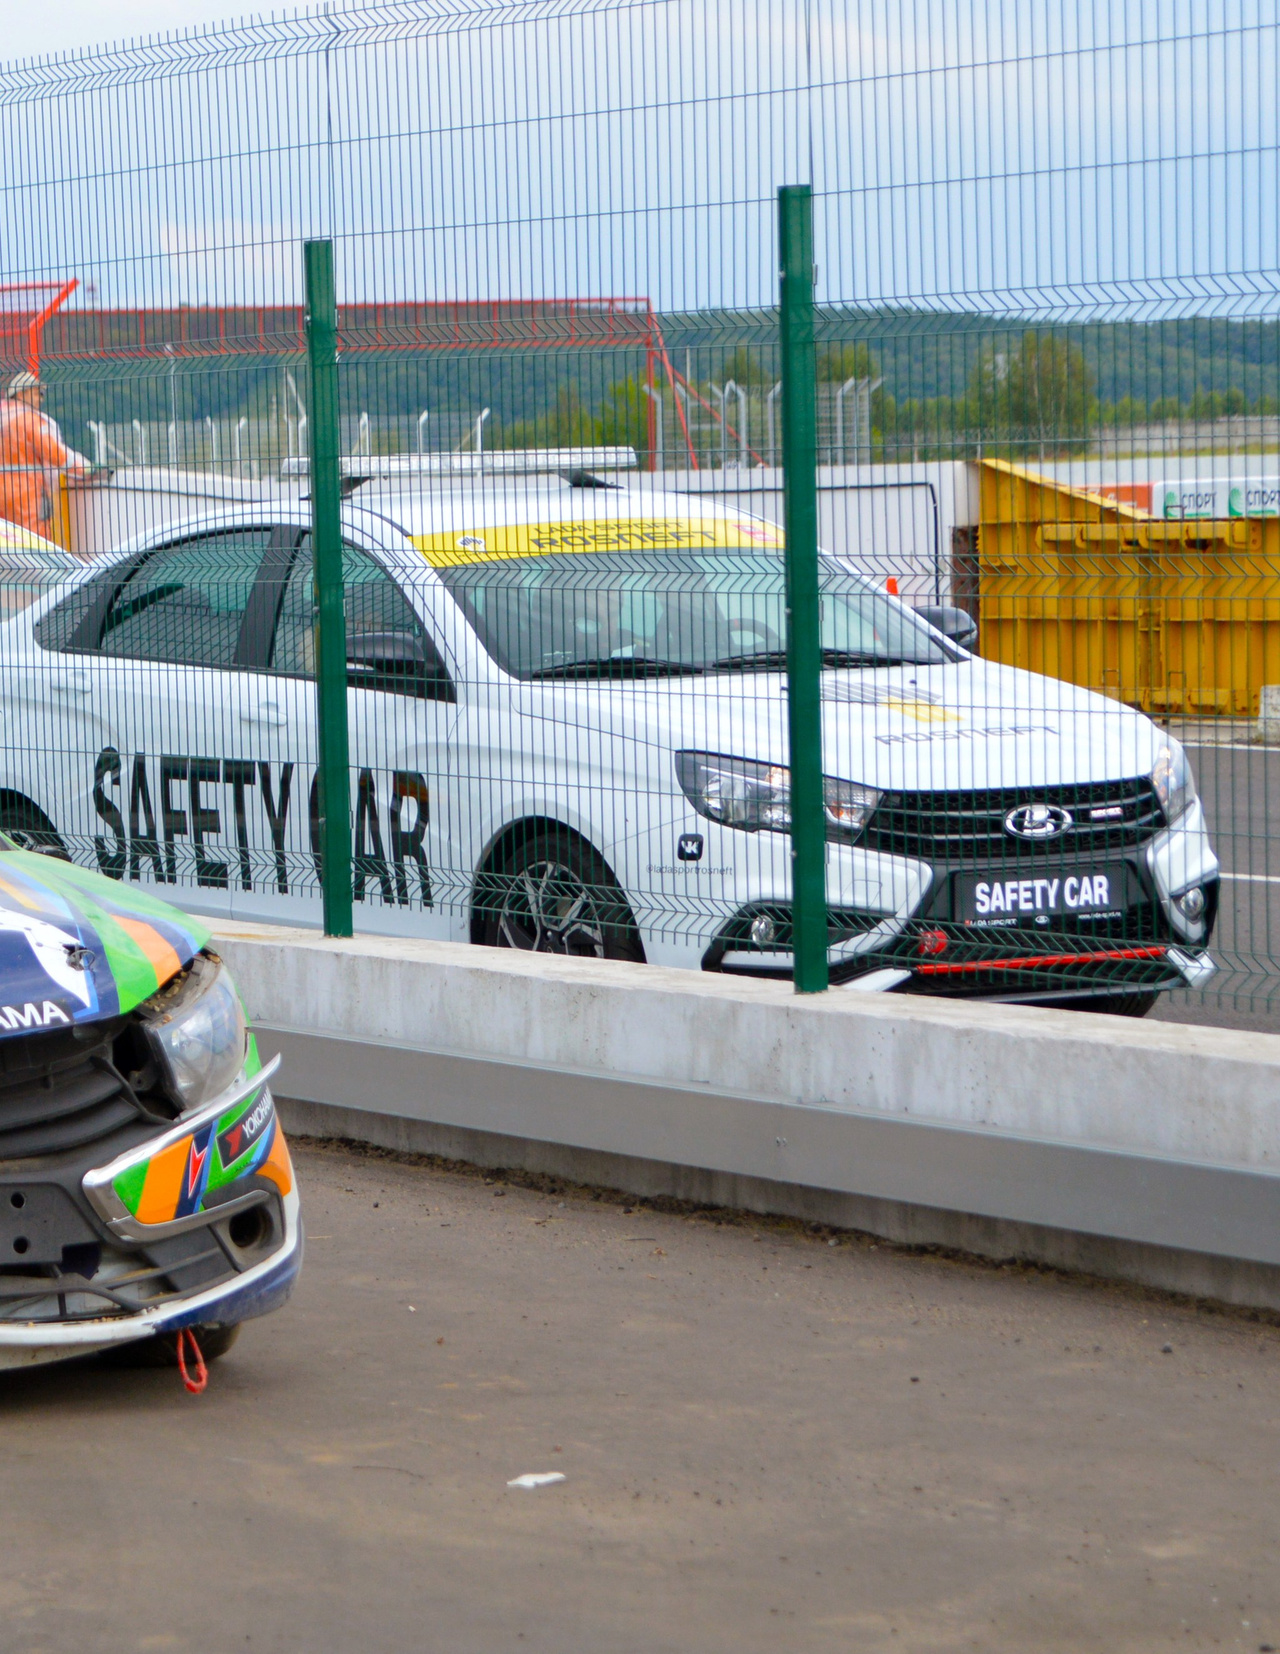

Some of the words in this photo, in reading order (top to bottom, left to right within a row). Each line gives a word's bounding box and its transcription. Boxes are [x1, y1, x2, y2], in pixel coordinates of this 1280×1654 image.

[93, 746, 295, 894] SAFETY
[975, 878, 1060, 914] SAFETY
[1063, 874, 1110, 908] CAR
